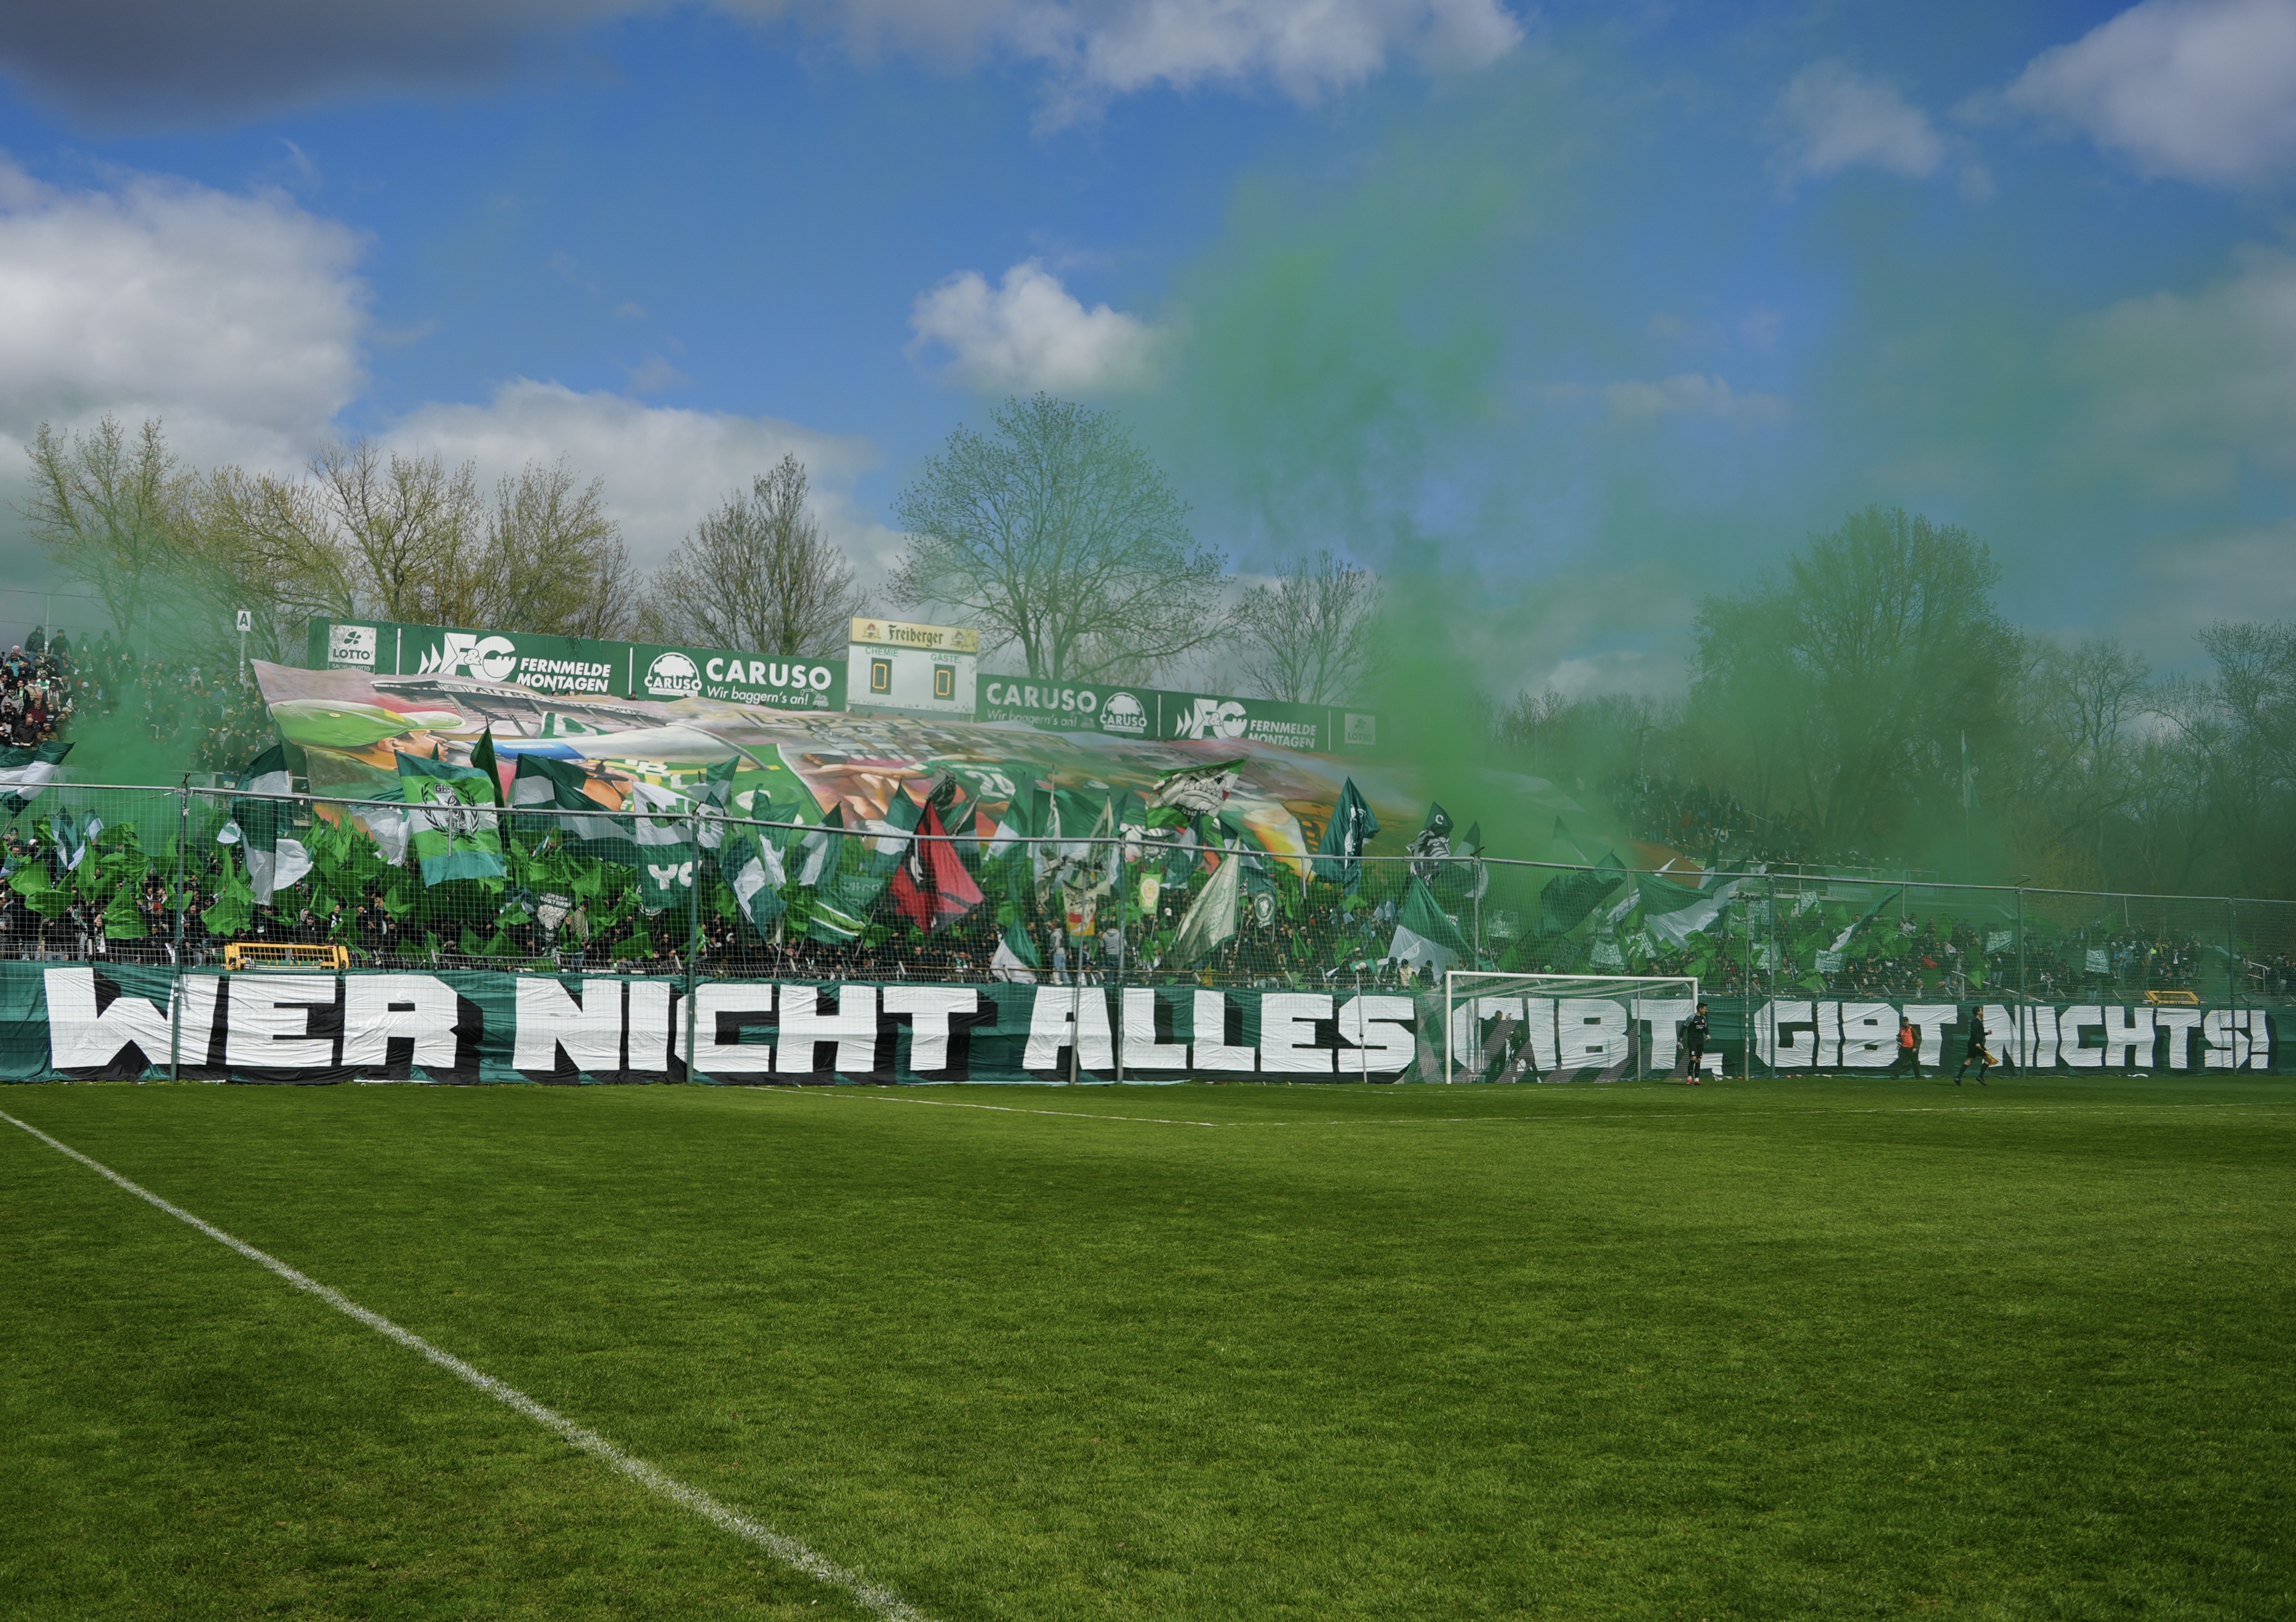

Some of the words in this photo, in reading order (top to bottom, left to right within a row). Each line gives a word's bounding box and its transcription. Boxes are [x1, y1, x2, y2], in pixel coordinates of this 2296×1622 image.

[239, 613, 249, 627] A
[888, 624, 944, 647] Freiberger
[333, 649, 370, 660] LOTTO
[865, 646, 899, 657] CHEMIE
[520, 657, 612, 678] FERNMELDE
[706, 657, 832, 691] CARUSO
[516, 673, 609, 693] MONTAGEN
[644, 676, 703, 691] CARUSO
[872, 662, 888, 689] 0
[935, 669, 951, 696] 0
[706, 685, 729, 699] Wir
[731, 686, 787, 705] baggern's
[790, 693, 809, 705] an!
[986, 682, 1097, 713] CARUSO
[986, 708, 1007, 720] Wir
[1061, 716, 1077, 727] an!
[1100, 714, 1147, 728] CARUSO
[1250, 719, 1317, 737] FERNMELDE
[1348, 731, 1374, 742] LOTTO
[1248, 732, 1315, 749] MONTAGEN
[44, 967, 458, 1069] WER
[512, 976, 978, 1073] NICHT
[1022, 985, 1416, 1074] ALLES
[1754, 1000, 1957, 1067] GIBT
[1983, 1004, 2269, 1069] NICHTS!
